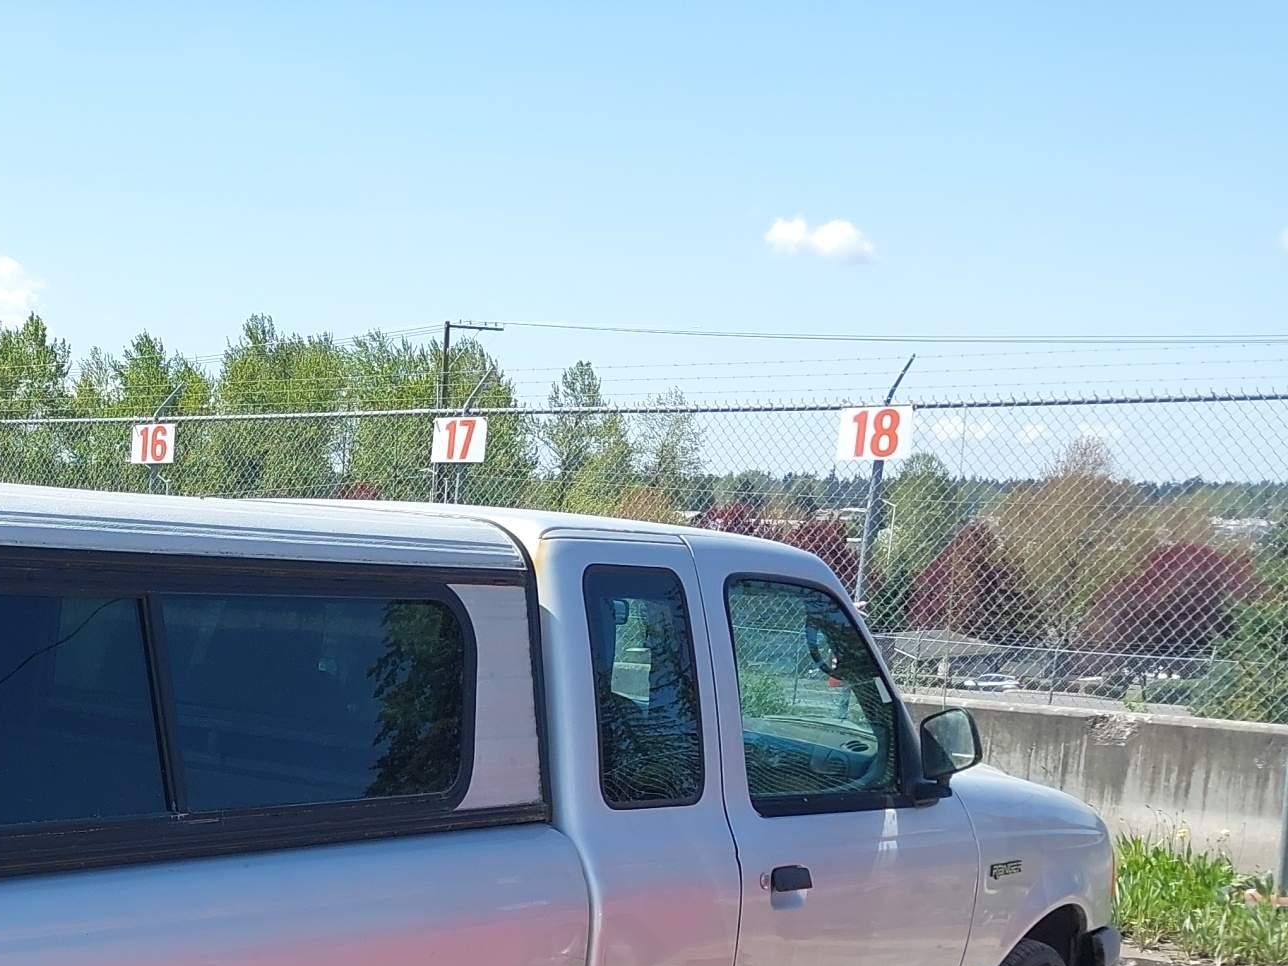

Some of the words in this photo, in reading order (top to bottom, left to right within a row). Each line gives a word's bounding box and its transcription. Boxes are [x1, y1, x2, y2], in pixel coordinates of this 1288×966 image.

[140, 425, 167, 462] 16
[445, 419, 477, 460] 17
[853, 408, 900, 458] 18
